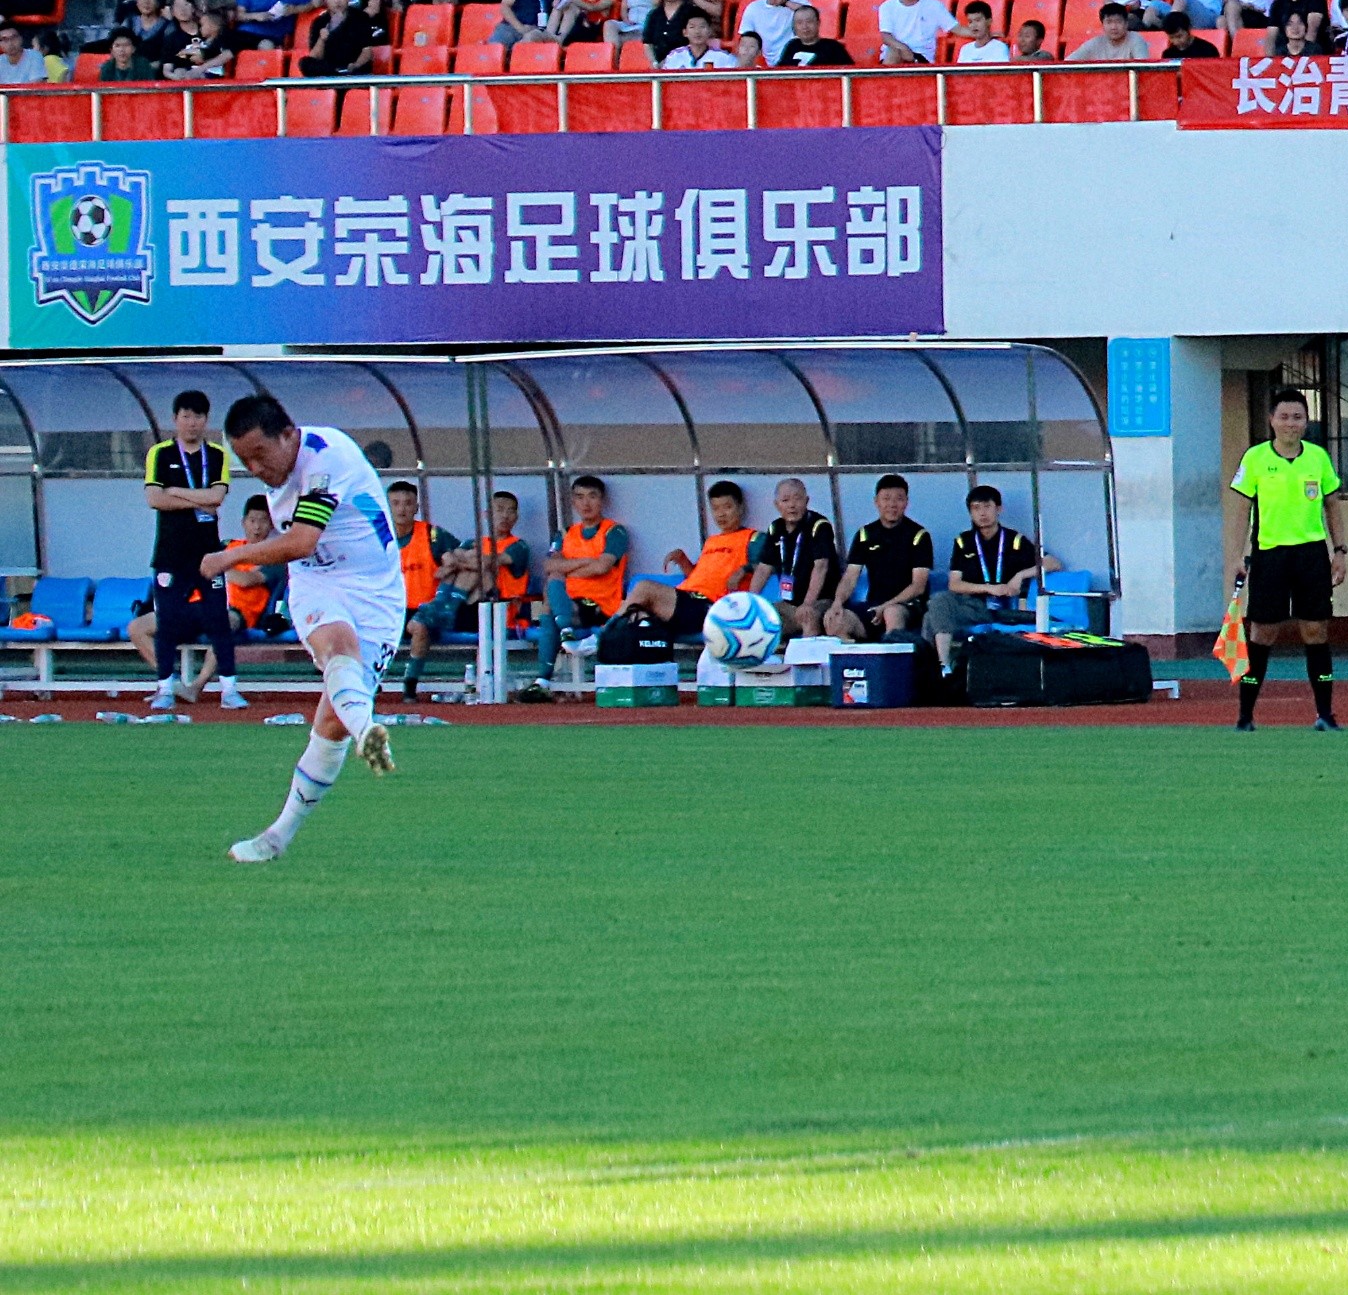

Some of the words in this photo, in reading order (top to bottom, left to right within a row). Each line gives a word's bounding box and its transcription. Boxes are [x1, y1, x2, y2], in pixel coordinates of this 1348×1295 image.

[167, 186, 923, 287] 西安荣海足球俱乐部
